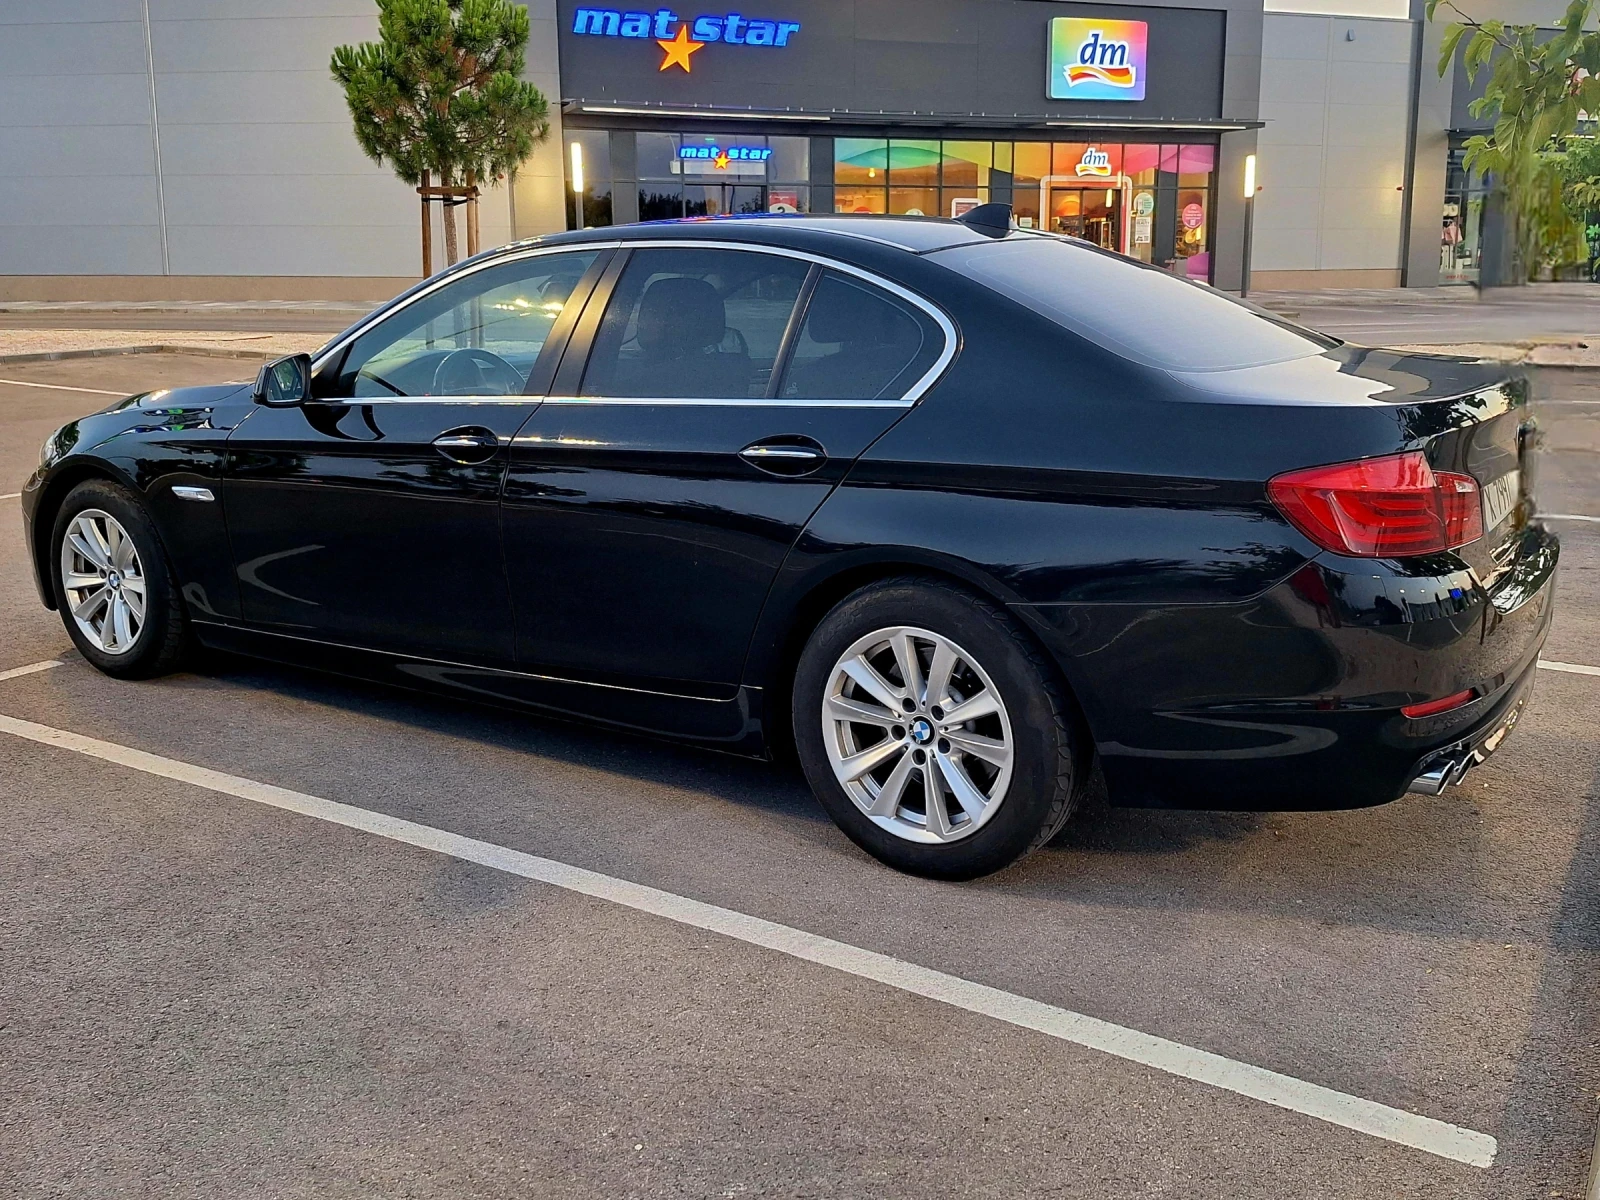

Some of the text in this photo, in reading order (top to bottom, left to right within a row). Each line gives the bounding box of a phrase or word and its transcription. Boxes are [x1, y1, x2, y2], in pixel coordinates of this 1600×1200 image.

[573, 9, 800, 47] mat star
[1080, 34, 1126, 66] dm
[680, 146, 771, 159] mat star
[1084, 151, 1106, 165] dm
